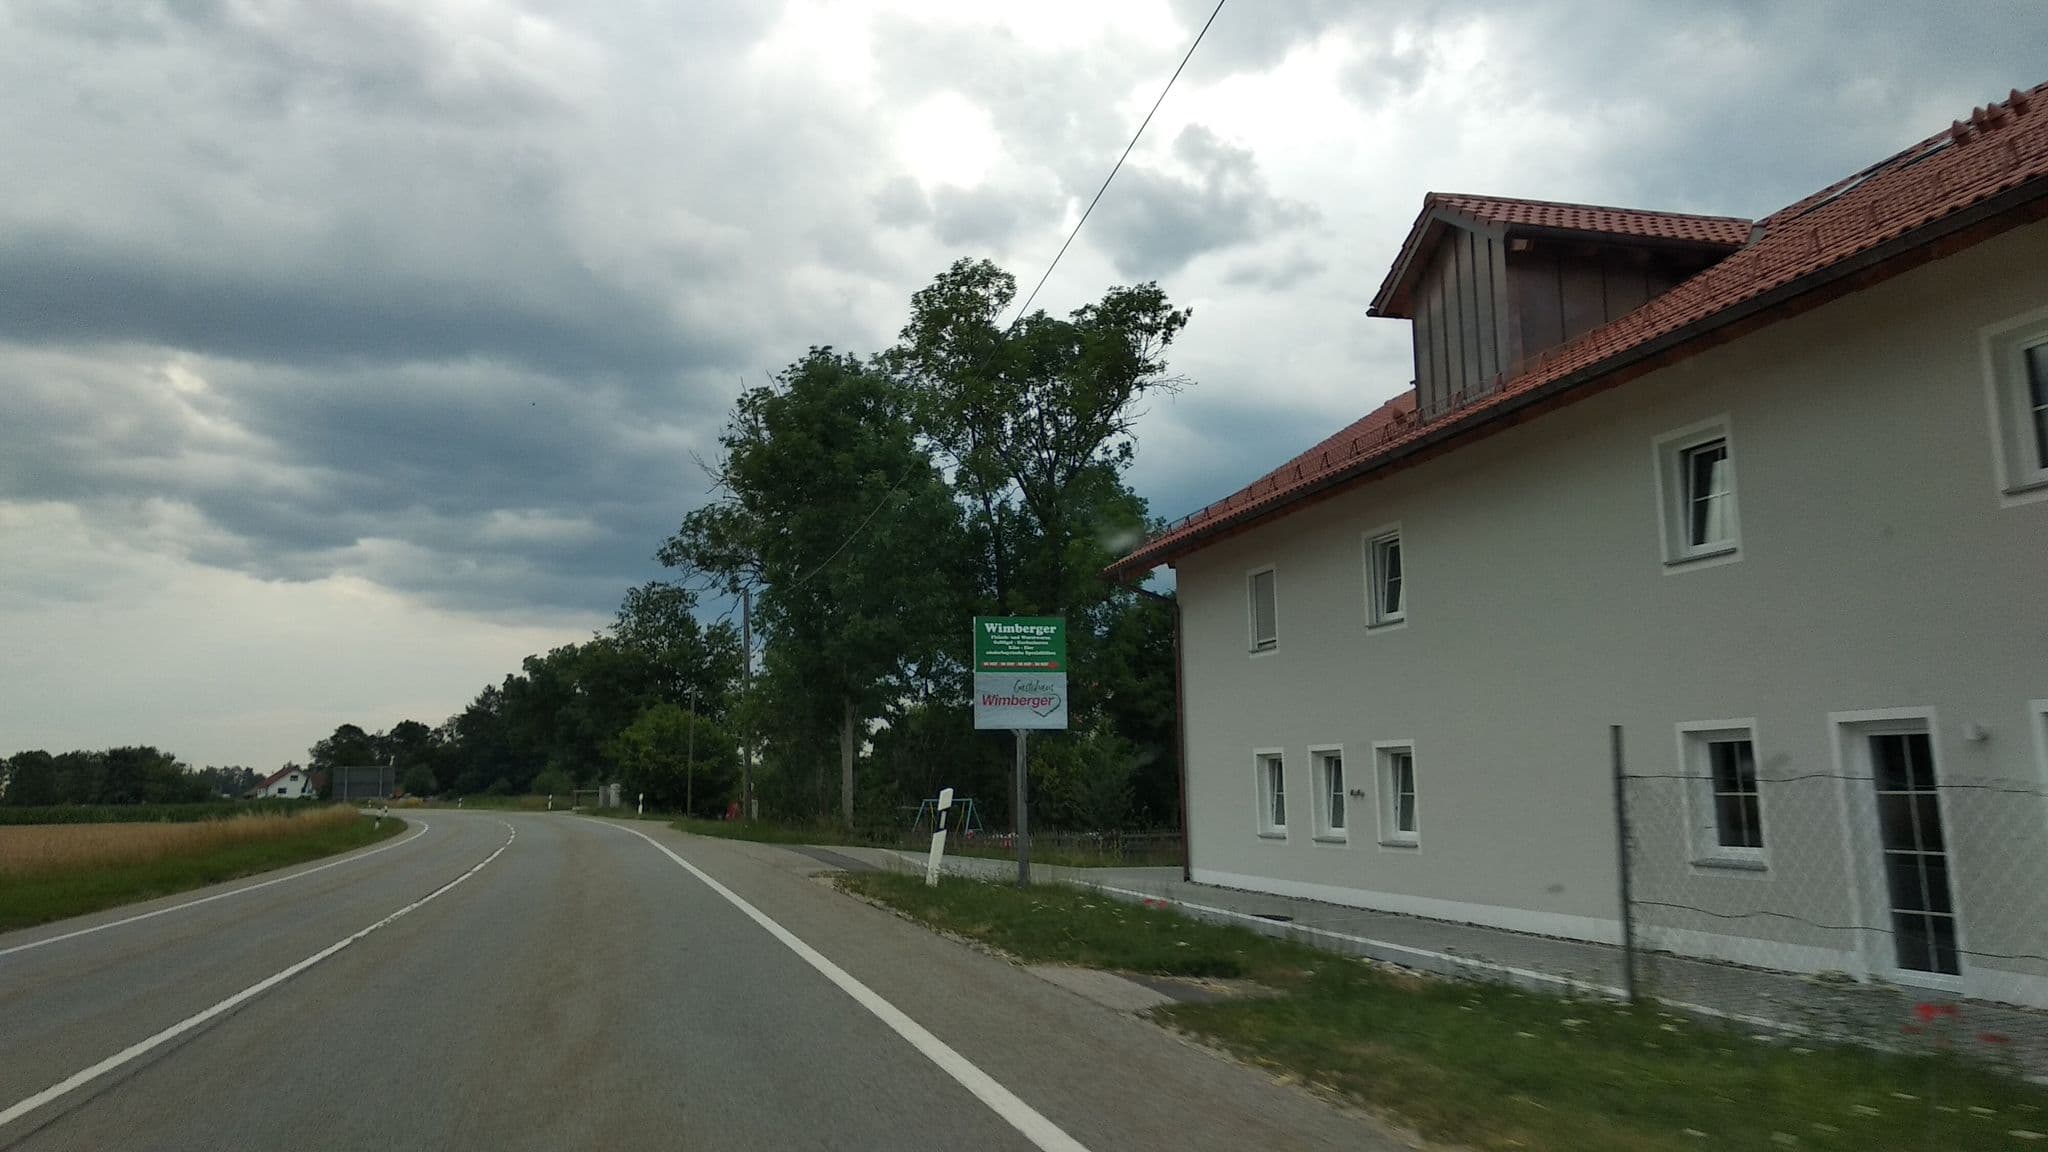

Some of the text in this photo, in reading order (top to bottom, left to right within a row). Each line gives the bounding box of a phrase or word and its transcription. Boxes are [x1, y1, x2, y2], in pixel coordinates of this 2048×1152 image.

[984, 623, 1057, 635] Wimberger
[1013, 680, 1054, 693] Gasthaus
[982, 694, 1054, 708] Wimberger
